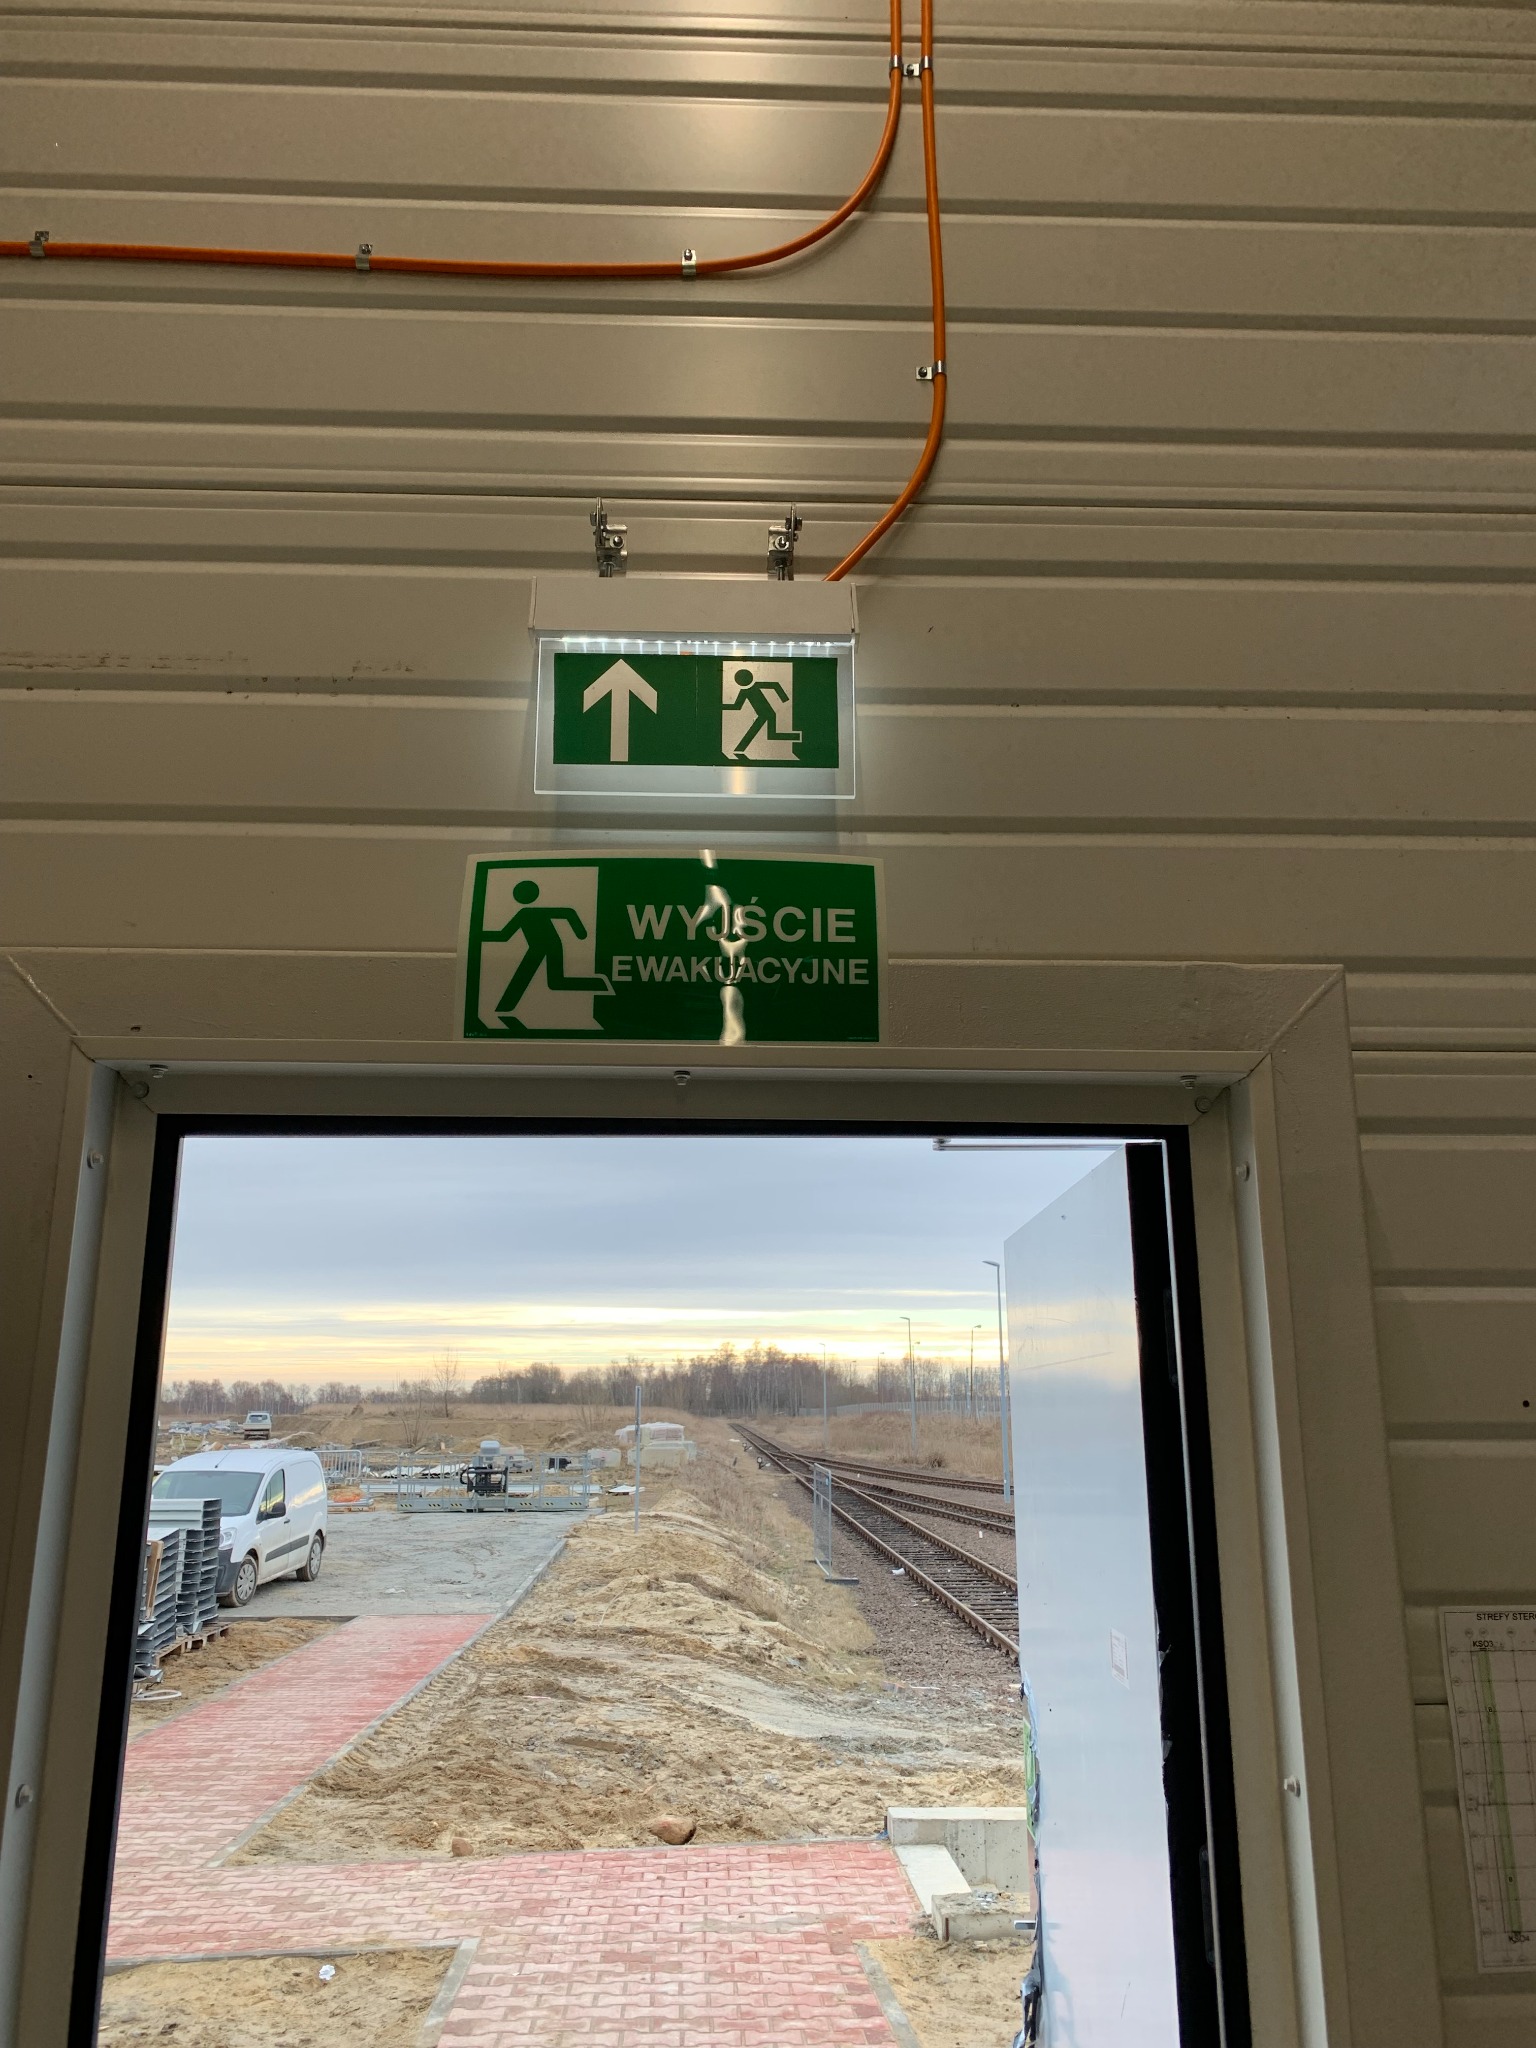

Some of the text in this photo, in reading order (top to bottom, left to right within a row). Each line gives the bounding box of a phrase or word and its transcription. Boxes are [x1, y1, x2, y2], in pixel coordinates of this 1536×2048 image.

[626, 897, 856, 943] WYJŚCIE
[612, 956, 869, 985] EWAKUACYJNE
[1476, 1613, 1510, 1621] STREFY
